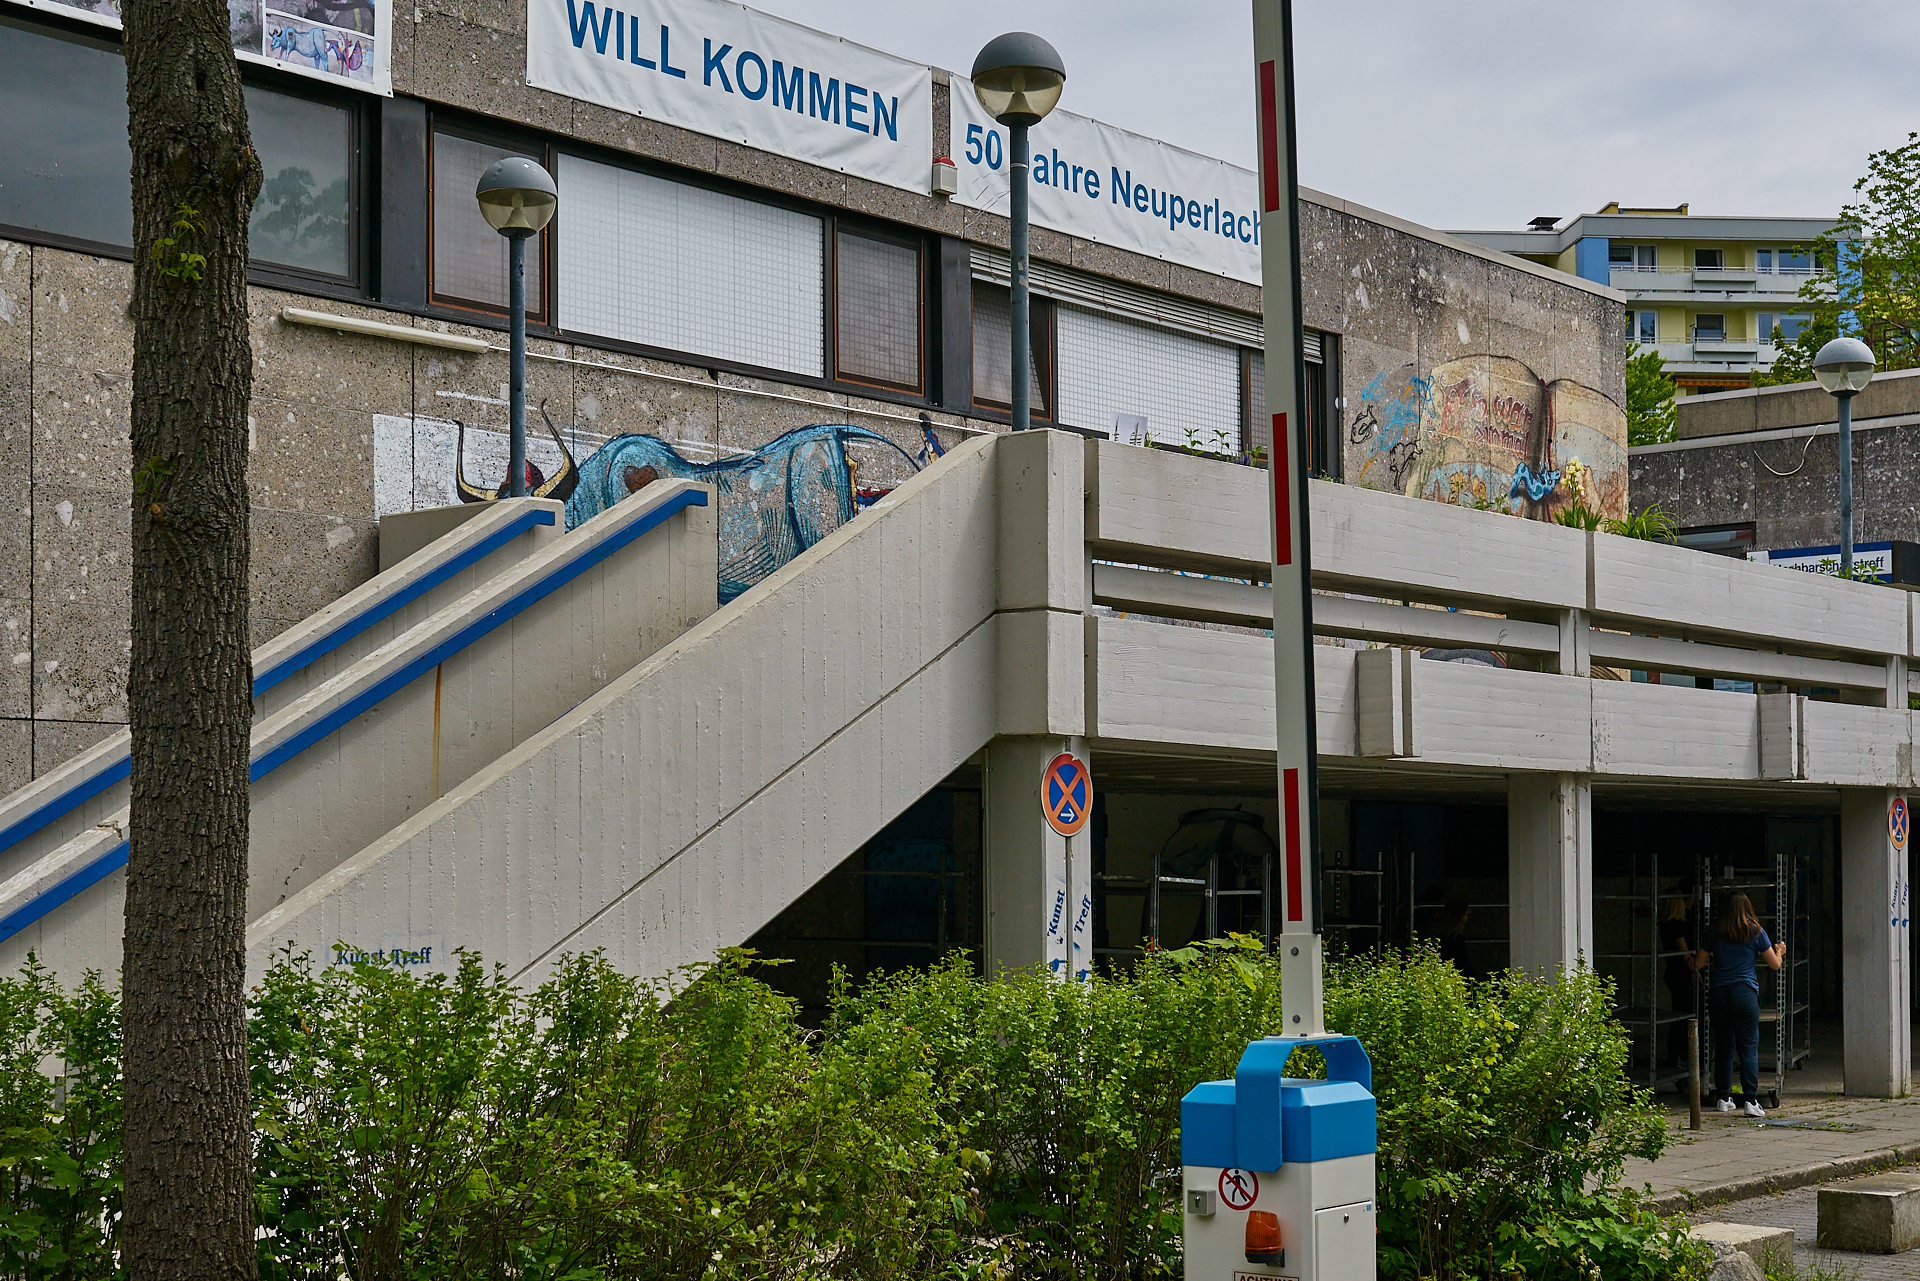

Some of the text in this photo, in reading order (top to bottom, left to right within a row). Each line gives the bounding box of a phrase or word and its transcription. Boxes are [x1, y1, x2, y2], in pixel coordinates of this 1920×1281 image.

[566, 0, 898, 142] WILL KOMMEN
[966, 123, 1003, 171] 50
[1026, 140, 1100, 199] ahre
[1493, 393, 1534, 433] war
